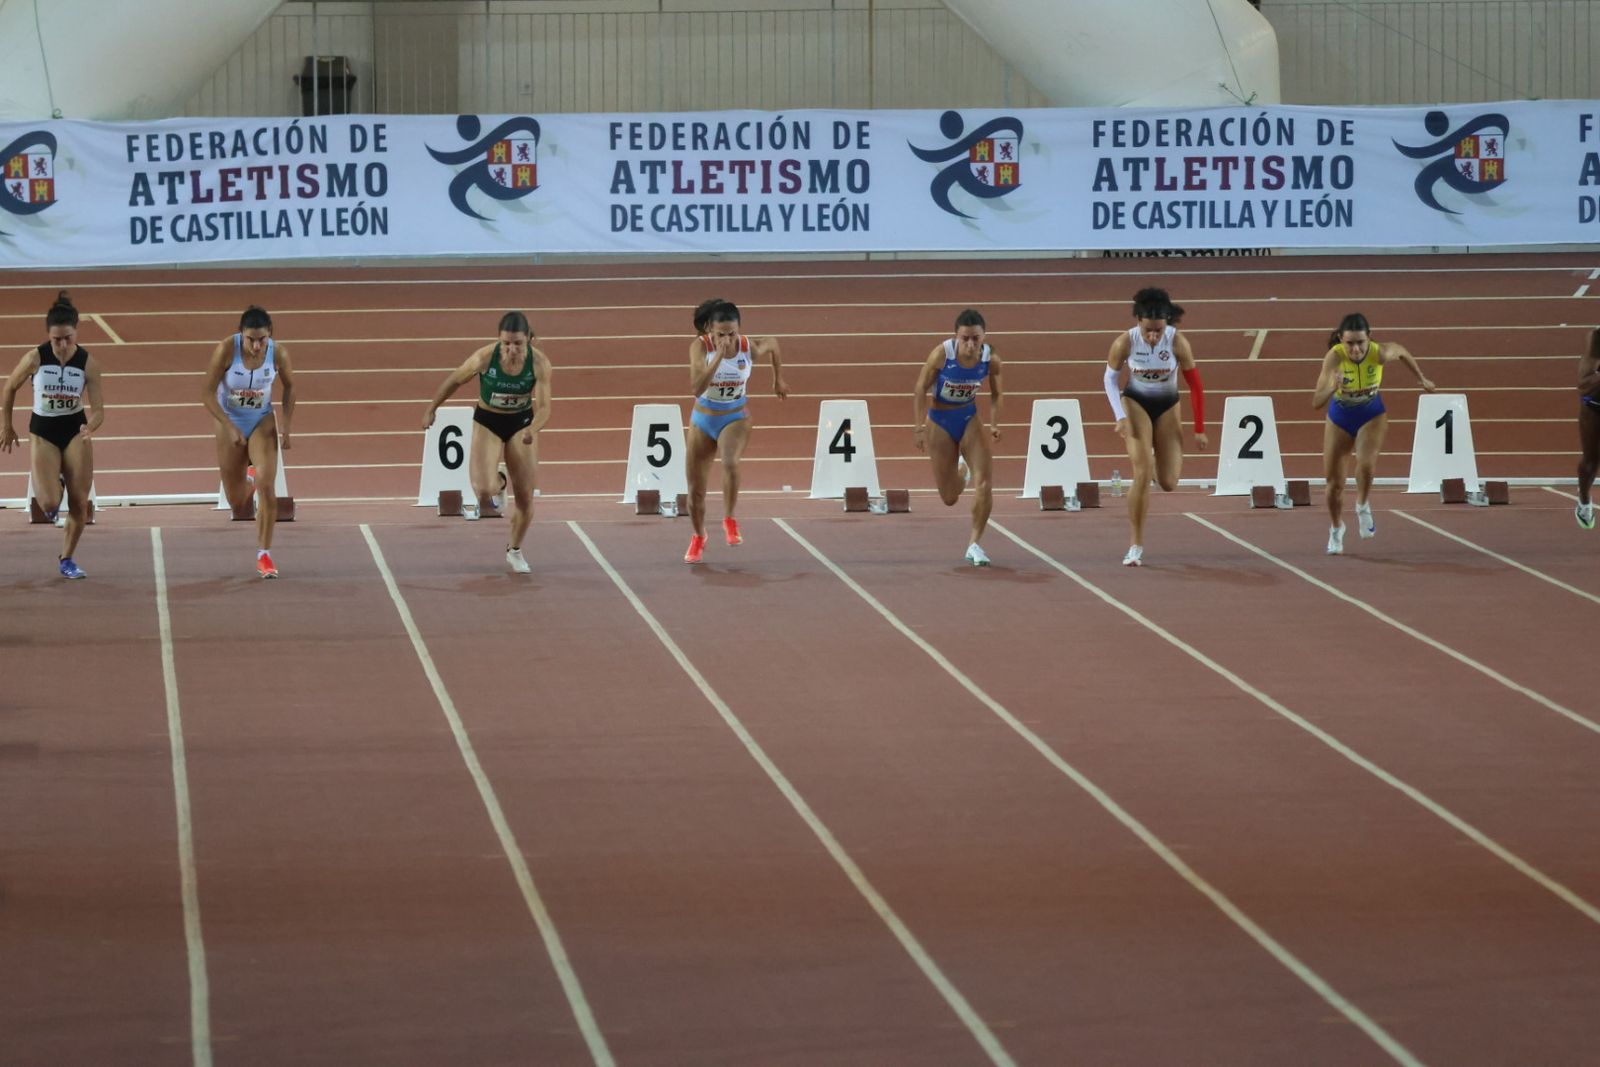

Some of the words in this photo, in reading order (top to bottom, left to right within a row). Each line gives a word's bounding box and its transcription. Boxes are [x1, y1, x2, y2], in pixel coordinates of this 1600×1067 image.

[126, 118, 328, 163] FEDERACIÓN
[350, 123, 388, 153] DE
[609, 114, 810, 151] FEDERACIÓN
[832, 120, 870, 150] DE
[1092, 111, 1295, 148] FEDERACIÓN
[1316, 117, 1355, 147] DE
[1579, 112, 1600, 143] F
[128, 161, 389, 207] ATLETISMO
[609, 158, 871, 195] ATLETISMO
[1091, 154, 1355, 193] ATLETISMO
[130, 215, 165, 245] DE
[169, 208, 293, 244] CASTILLA
[296, 207, 315, 238] Y
[320, 200, 389, 237] LEÓN
[610, 203, 645, 233] DE
[650, 203, 774, 233] CASTILLA
[777, 203, 796, 232] Y
[801, 197, 870, 232] LEÓN
[1092, 200, 1127, 231] DE
[1132, 199, 1256, 230] CASTILLA
[1260, 199, 1280, 229] Y
[1284, 193, 1354, 229] LEÓN
[1578, 195, 1600, 224] D
[48, 399, 74, 410] 130
[239, 397, 255, 407] 14
[719, 387, 735, 397] 12
[438, 425, 464, 470] 6
[646, 423, 672, 468] 5
[829, 419, 856, 463] 4
[1041, 416, 1069, 460] 3
[1238, 415, 1264, 459] 2
[1436, 410, 1453, 455] 1
